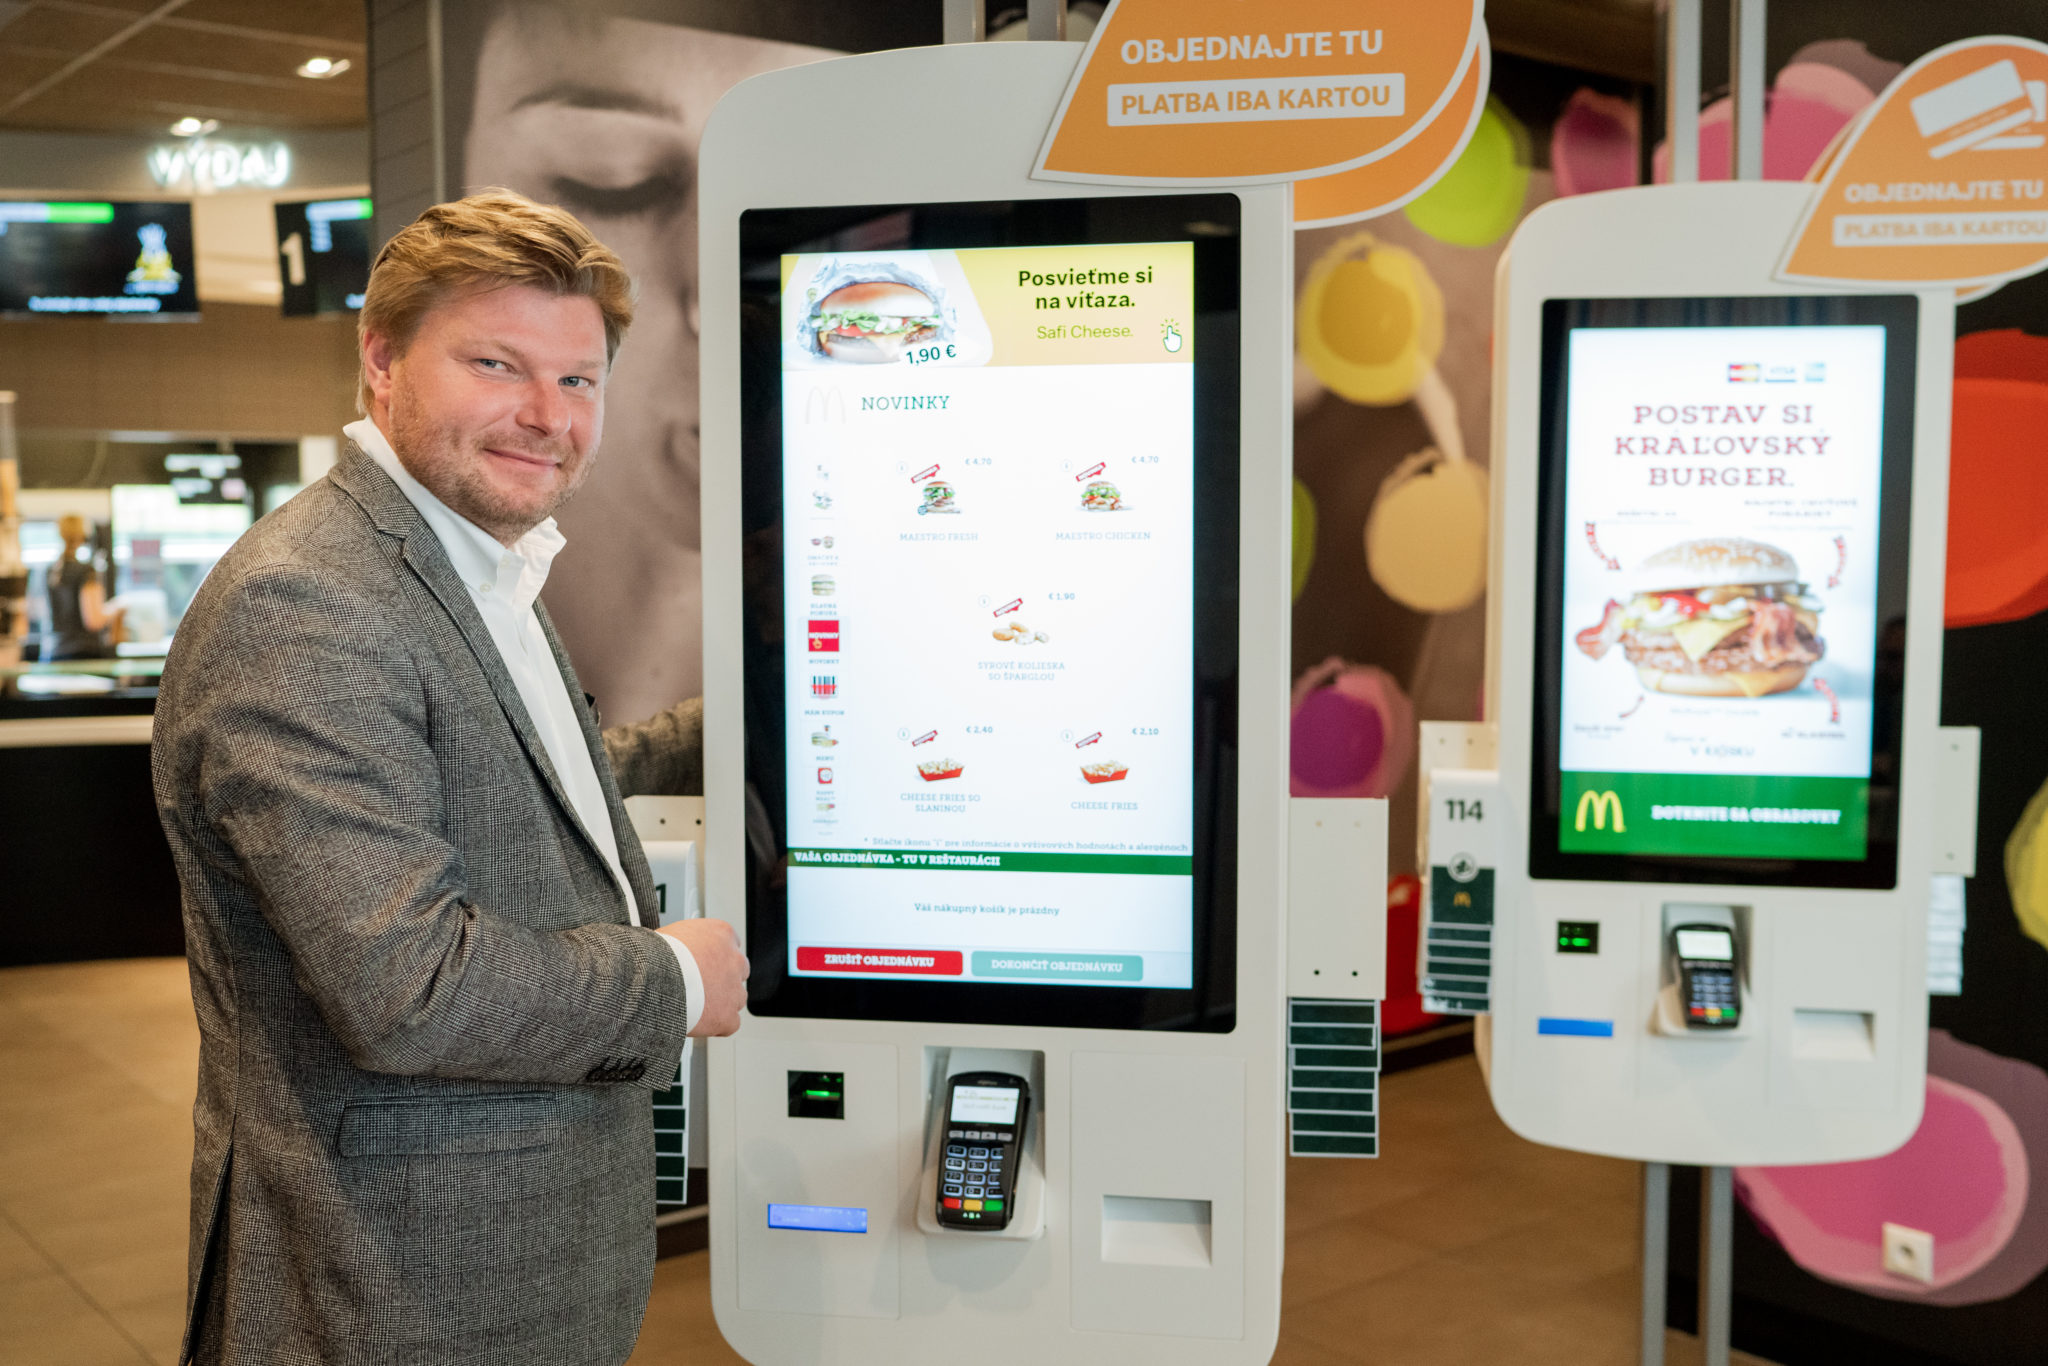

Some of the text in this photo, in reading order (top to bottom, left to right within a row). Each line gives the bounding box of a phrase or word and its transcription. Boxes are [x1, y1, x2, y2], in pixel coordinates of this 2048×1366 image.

[1121, 29, 1384, 65] OBJEDNAJTE TU
[1121, 85, 1392, 116] PLATBA IBA KARTOU
[1844, 179, 2044, 203] OBJEDNAJTE TU
[1844, 219, 2047, 238] PLATBA IBA KARTOU
[1018, 266, 1153, 287] Posvieťme si
[1035, 291, 1136, 310] na víťaza.
[1037, 324, 1134, 340] Safi Cheese.
[906, 344, 957, 366] 1,90 €
[861, 395, 950, 411] NOVINKY
[1633, 404, 1813, 424] POSTAV SI
[1649, 467, 1795, 487] BURGER.
[900, 533, 978, 541] MAESTRO FRESH
[1056, 532, 1151, 540] MAESTRO CHICKEN
[978, 661, 1065, 671] SYROVÉ KOLIESKA
[988, 673, 1001, 681] SO
[900, 793, 937, 801] CHEESE
[939, 794, 966, 802] FRIES
[915, 805, 966, 813] SLANINOU
[1071, 802, 1108, 810] CHEESE
[1444, 799, 1484, 821] 114
[795, 851, 822, 862] VAŠA
[823, 852, 894, 864] OBJEDNÁVKA
[902, 854, 918, 864] TU
[920, 855, 928, 865] V
[929, 853, 1000, 866] REŠTAURÁCII
[914, 903, 931, 911] Váš
[934, 904, 977, 913] nákupný
[1008, 906, 1017, 915] je
[1019, 906, 1060, 916] prázdny
[863, 955, 935, 968] OBJEDNÁVKU
[991, 958, 1123, 973] DOKONČIŤ OBJEDNÁVKU
